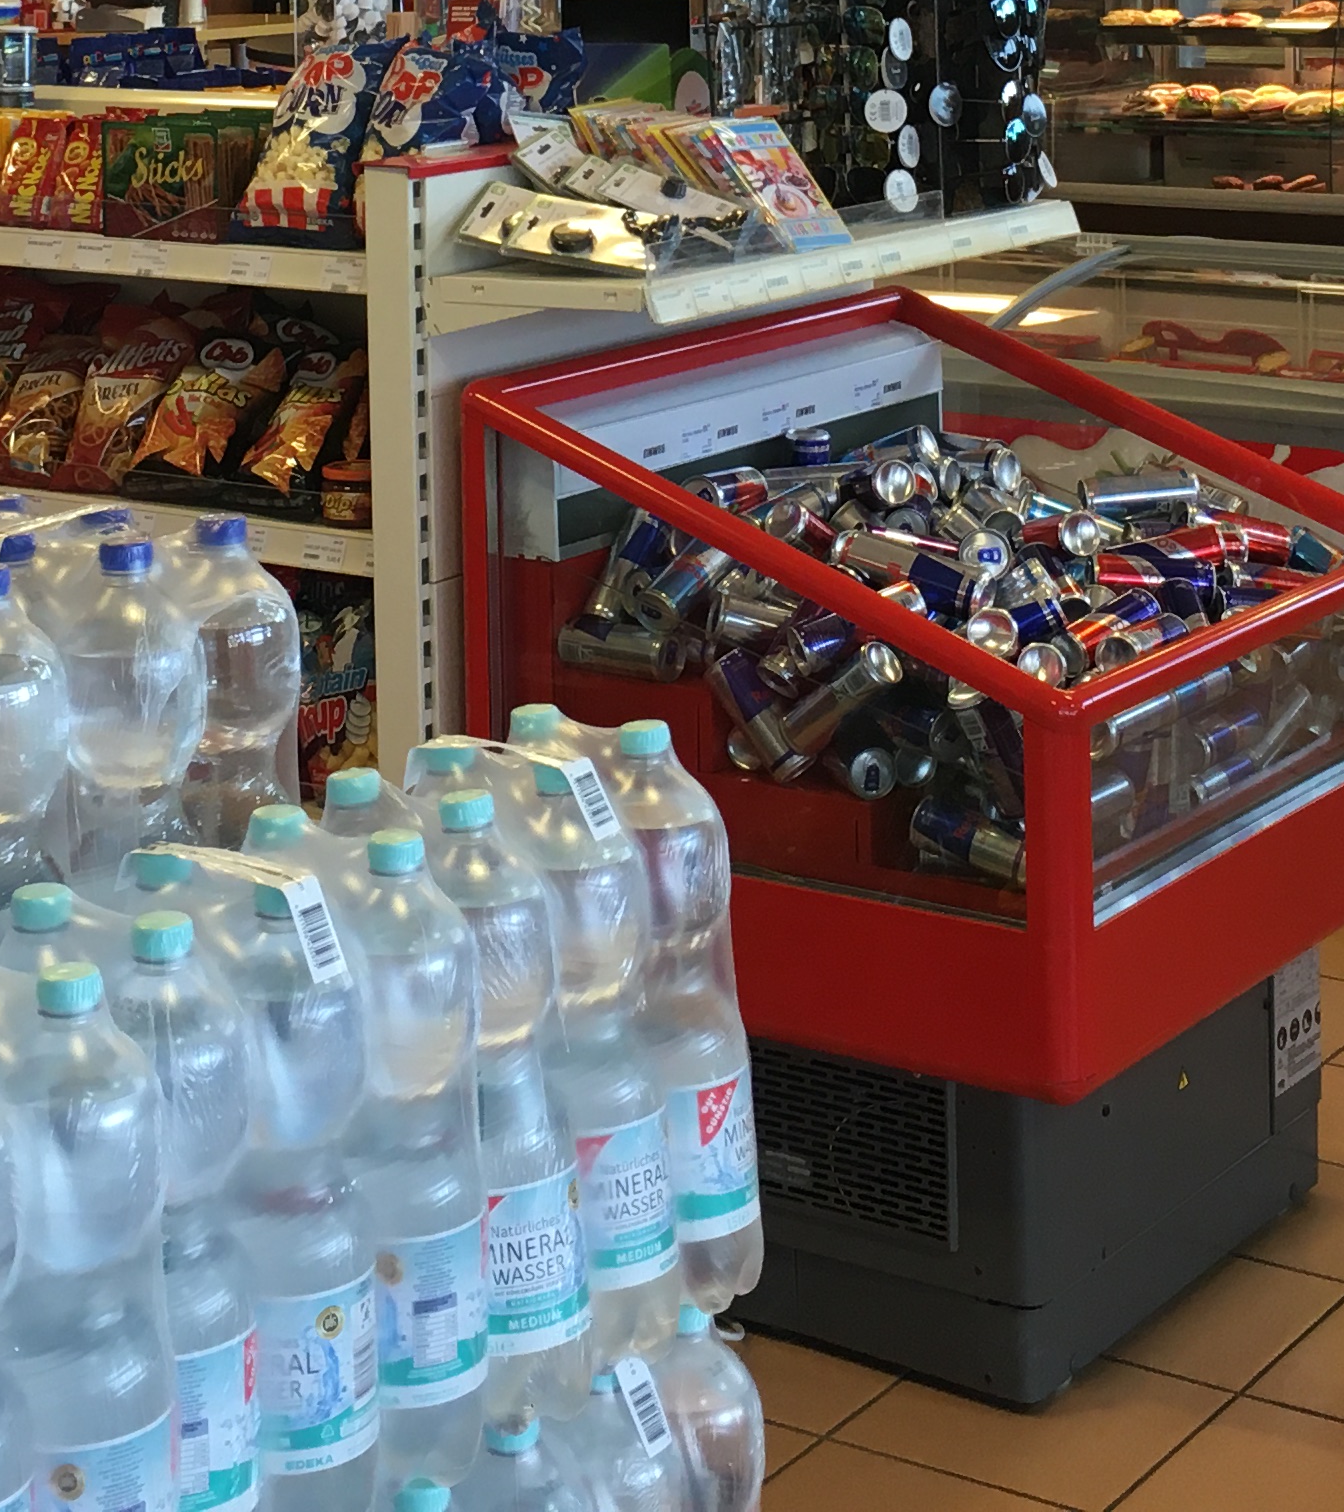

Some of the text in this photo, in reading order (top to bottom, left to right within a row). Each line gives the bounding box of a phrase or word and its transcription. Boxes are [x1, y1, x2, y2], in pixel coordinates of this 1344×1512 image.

[131, 148, 204, 187] Sticks
[206, 345, 252, 366] Chio
[700, 1092, 717, 1114] GUT
[705, 1086, 736, 1135] GÜNSTIG
[605, 1151, 660, 1176] Natürliches
[605, 1188, 666, 1221] WASSER
[491, 1214, 561, 1239] Natürliches
[615, 1241, 662, 1265] MEDIUM
[493, 1254, 566, 1286] WASSER
[508, 1309, 563, 1333] MEDIUM
[285, 1453, 335, 1471] EDEKA
